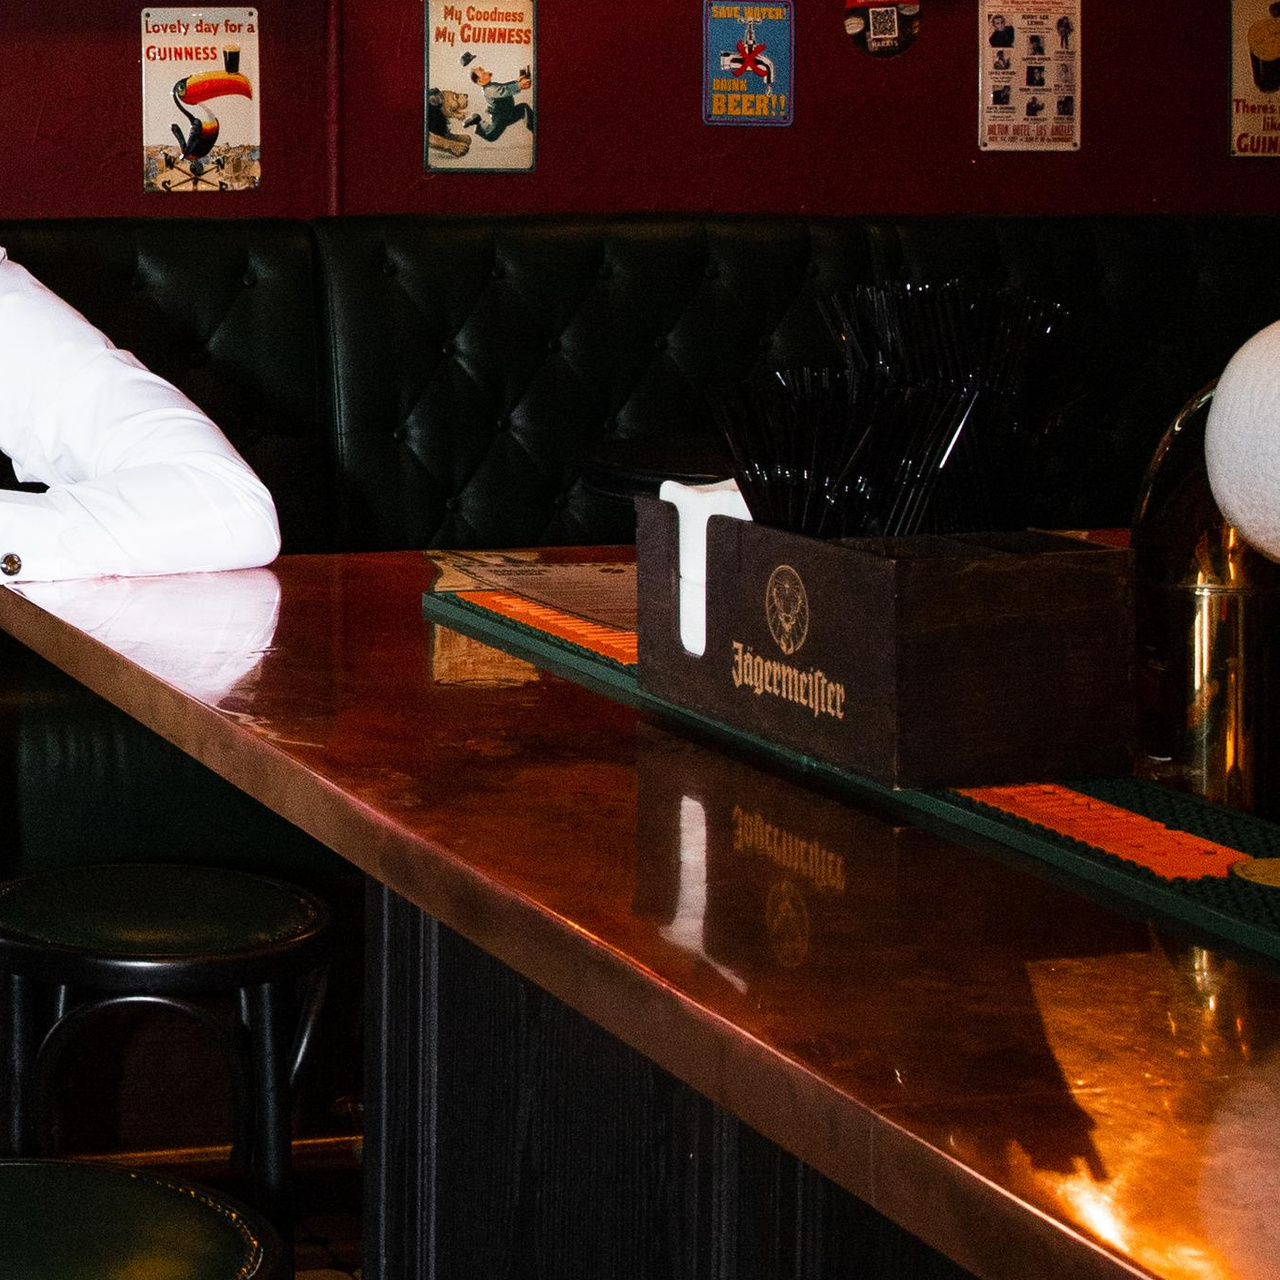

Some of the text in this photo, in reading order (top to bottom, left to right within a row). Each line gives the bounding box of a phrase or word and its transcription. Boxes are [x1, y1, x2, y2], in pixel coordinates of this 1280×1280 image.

[443, 5, 524, 25] My Goodness
[145, 19, 255, 36] Lovely day for a
[435, 23, 532, 47] My GUINNESS
[145, 45, 218, 61] GUINNESS
[712, 94, 787, 116] BEER!!
[1233, 98, 1276, 114] There's
[732, 640, 846, 720] Jägermeister
